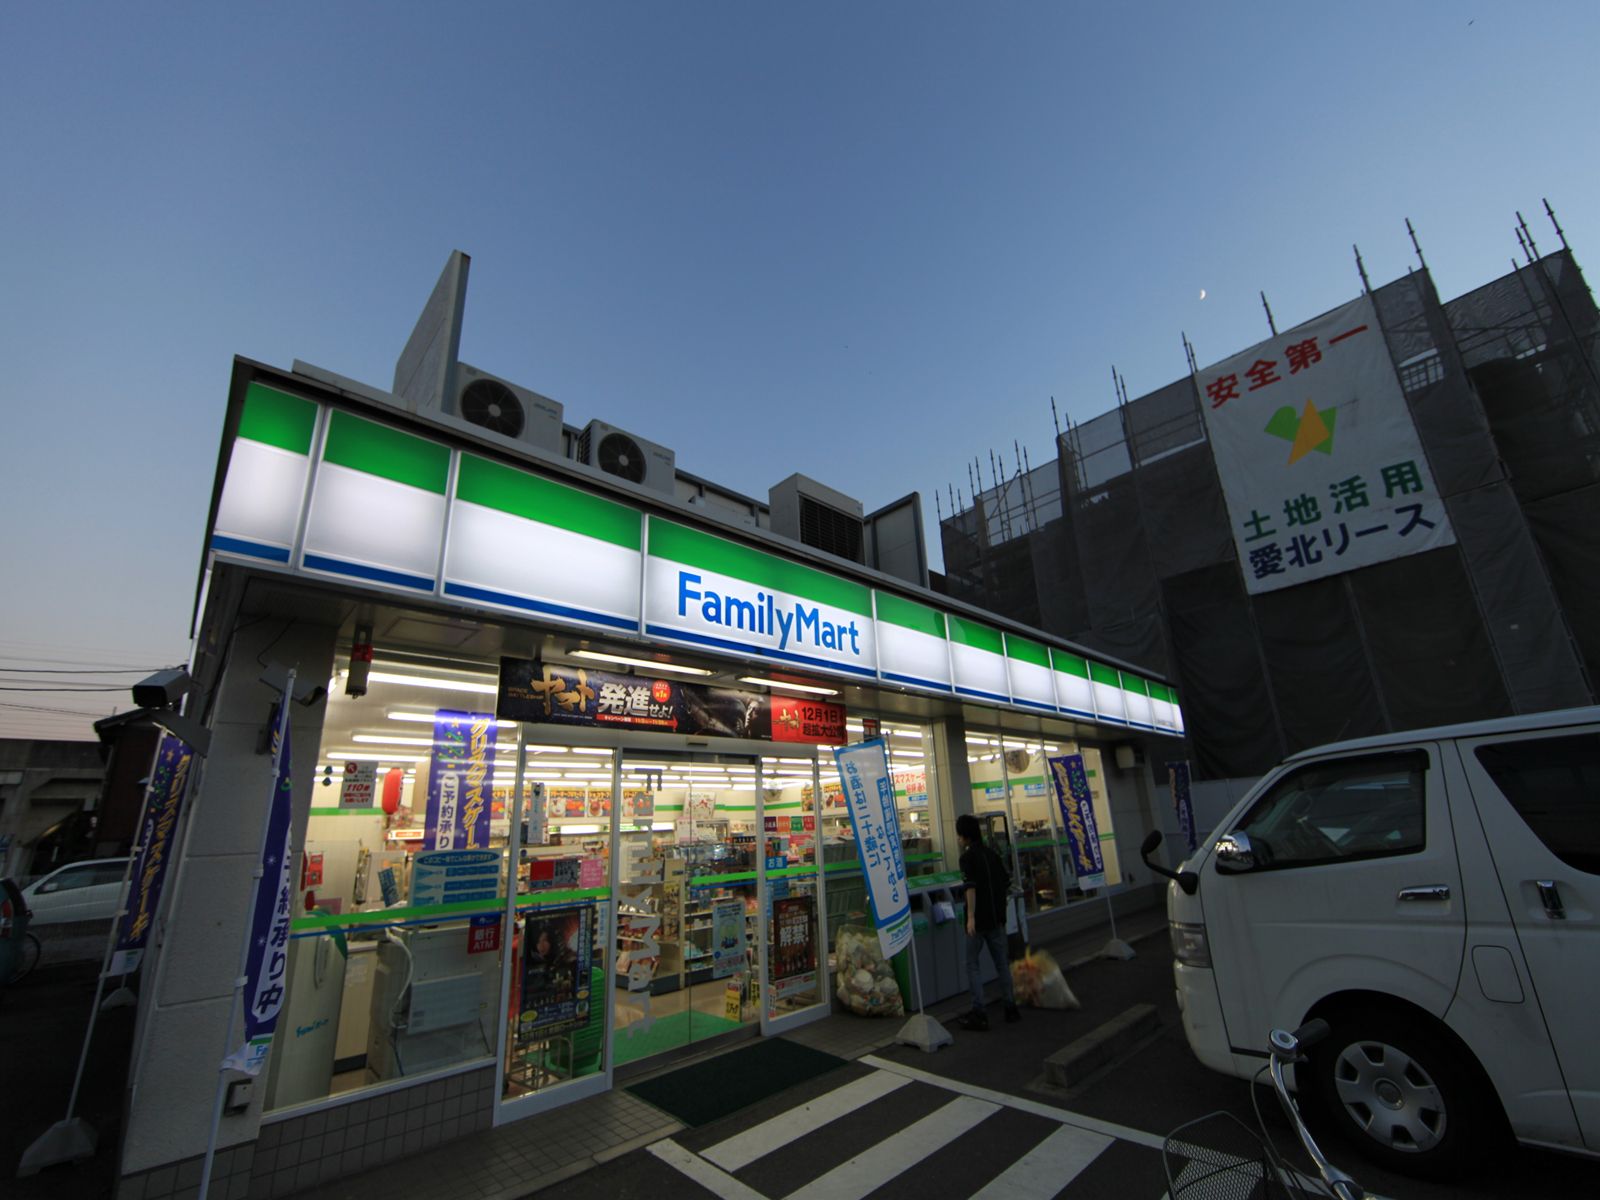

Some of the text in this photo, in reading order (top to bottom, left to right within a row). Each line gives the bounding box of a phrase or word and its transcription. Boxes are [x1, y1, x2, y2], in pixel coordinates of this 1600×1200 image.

[1206, 325, 1368, 410] 安全第一
[1243, 460, 1424, 543] 土地活用
[1249, 503, 1436, 580] 愛北リース
[678, 570, 860, 656] FamilyMart
[473, 940, 494, 951] ATM
